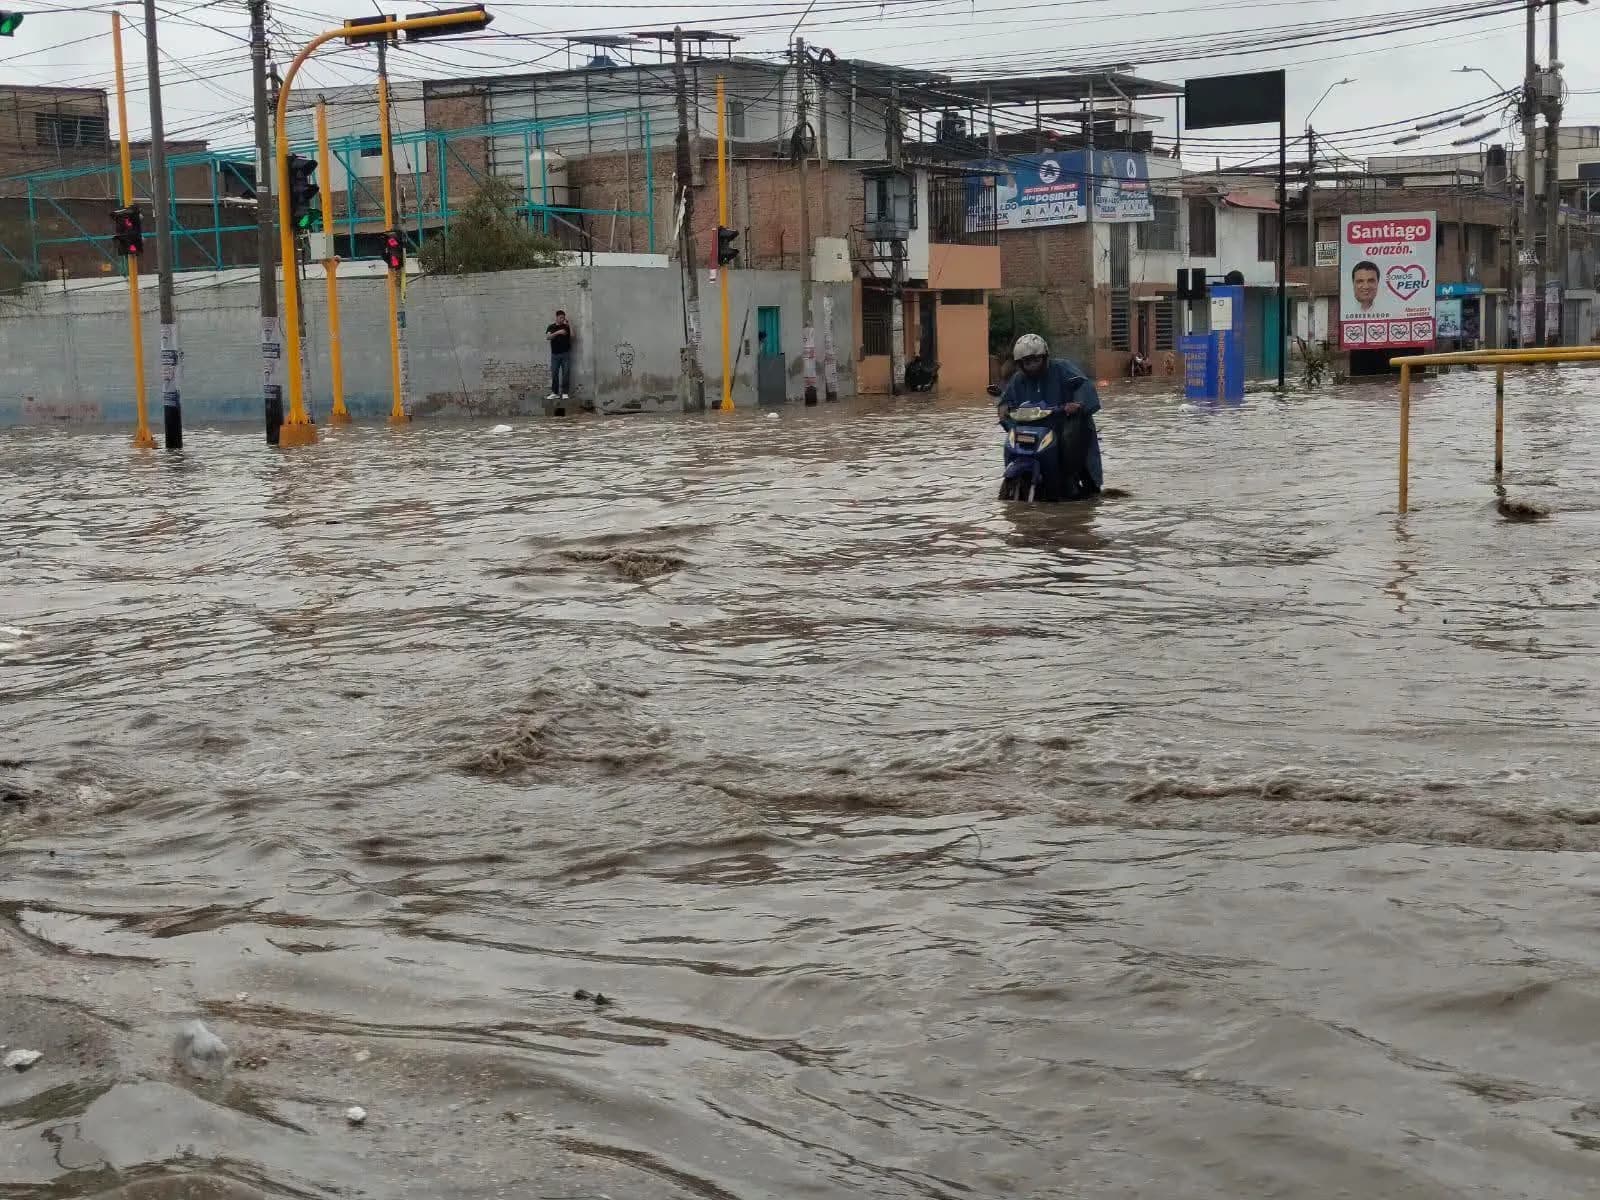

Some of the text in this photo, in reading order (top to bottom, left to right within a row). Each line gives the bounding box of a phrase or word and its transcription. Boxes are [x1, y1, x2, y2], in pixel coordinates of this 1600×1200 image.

[1351, 222, 1426, 241] Santiago
[1365, 242, 1413, 256] corazón.
[1385, 273, 1413, 281] SOMOS
